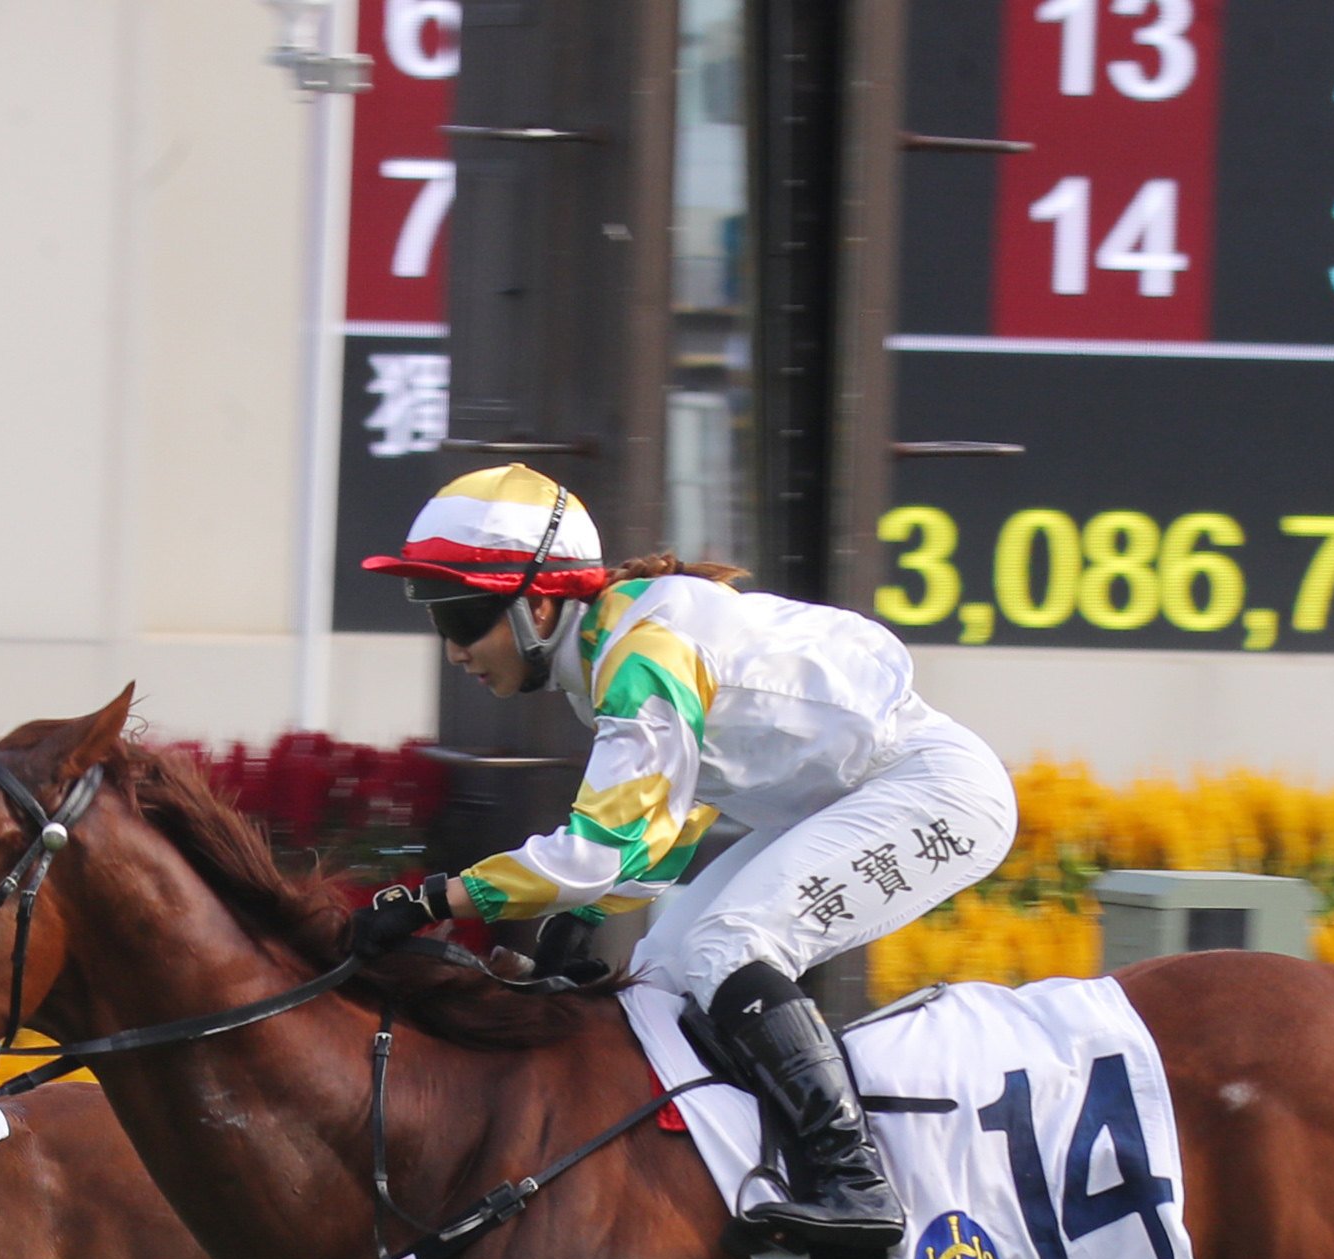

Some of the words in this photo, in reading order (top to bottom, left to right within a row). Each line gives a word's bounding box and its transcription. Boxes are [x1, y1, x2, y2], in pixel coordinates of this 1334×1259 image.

[1036, 0, 1196, 99] 13
[380, 159, 456, 277] 7
[1028, 177, 1189, 297] 14
[798, 818, 975, 934] 黃寶妮
